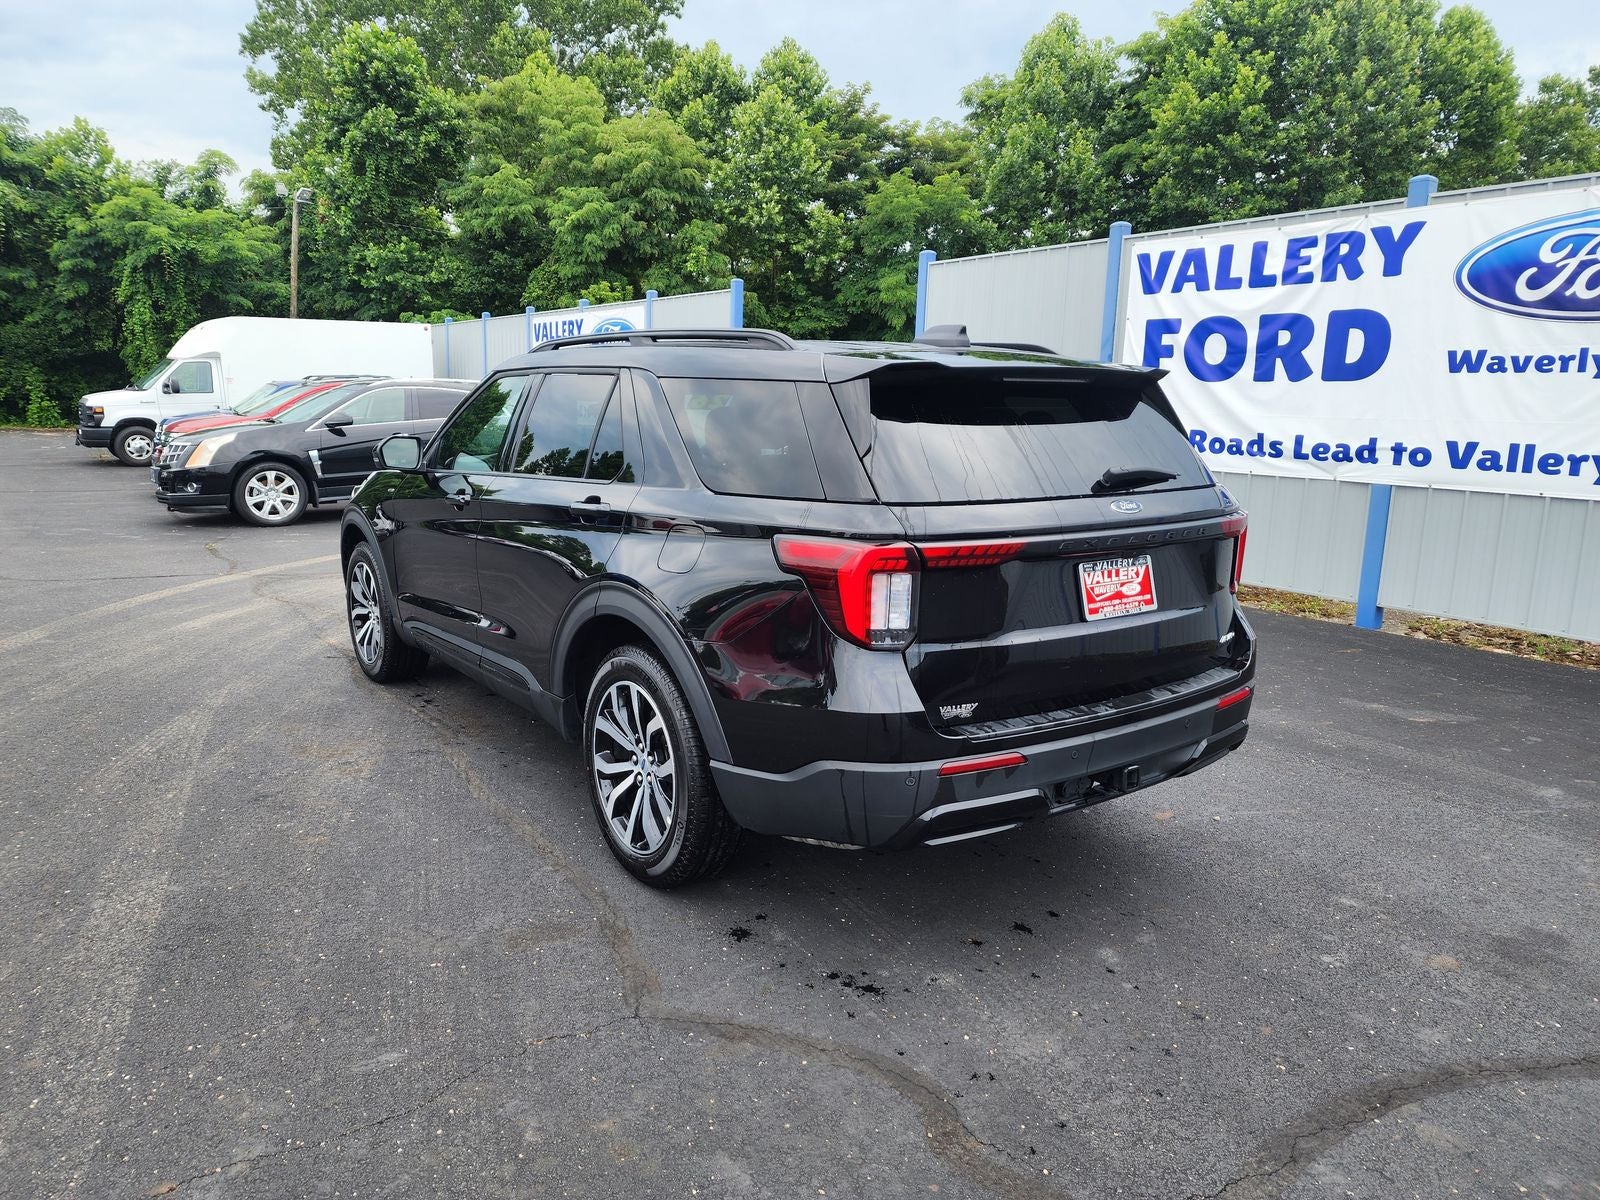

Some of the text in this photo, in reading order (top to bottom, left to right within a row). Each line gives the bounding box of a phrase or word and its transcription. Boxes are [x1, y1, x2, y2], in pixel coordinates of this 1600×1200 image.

[1137, 220, 1427, 295] VALLERY
[533, 318, 584, 343] VALLERY
[1141, 308, 1392, 383] FORD
[1188, 429, 1284, 459] Roads
[1293, 434, 1379, 465] Lead
[1390, 441, 1432, 467] to
[1058, 527, 1209, 550] EXPLORER
[1084, 565, 1147, 585] VALLERY
[1097, 557, 1133, 570] VALLERY
[1093, 584, 1121, 595] WAVERLY
[939, 702, 978, 713] VALLERY
